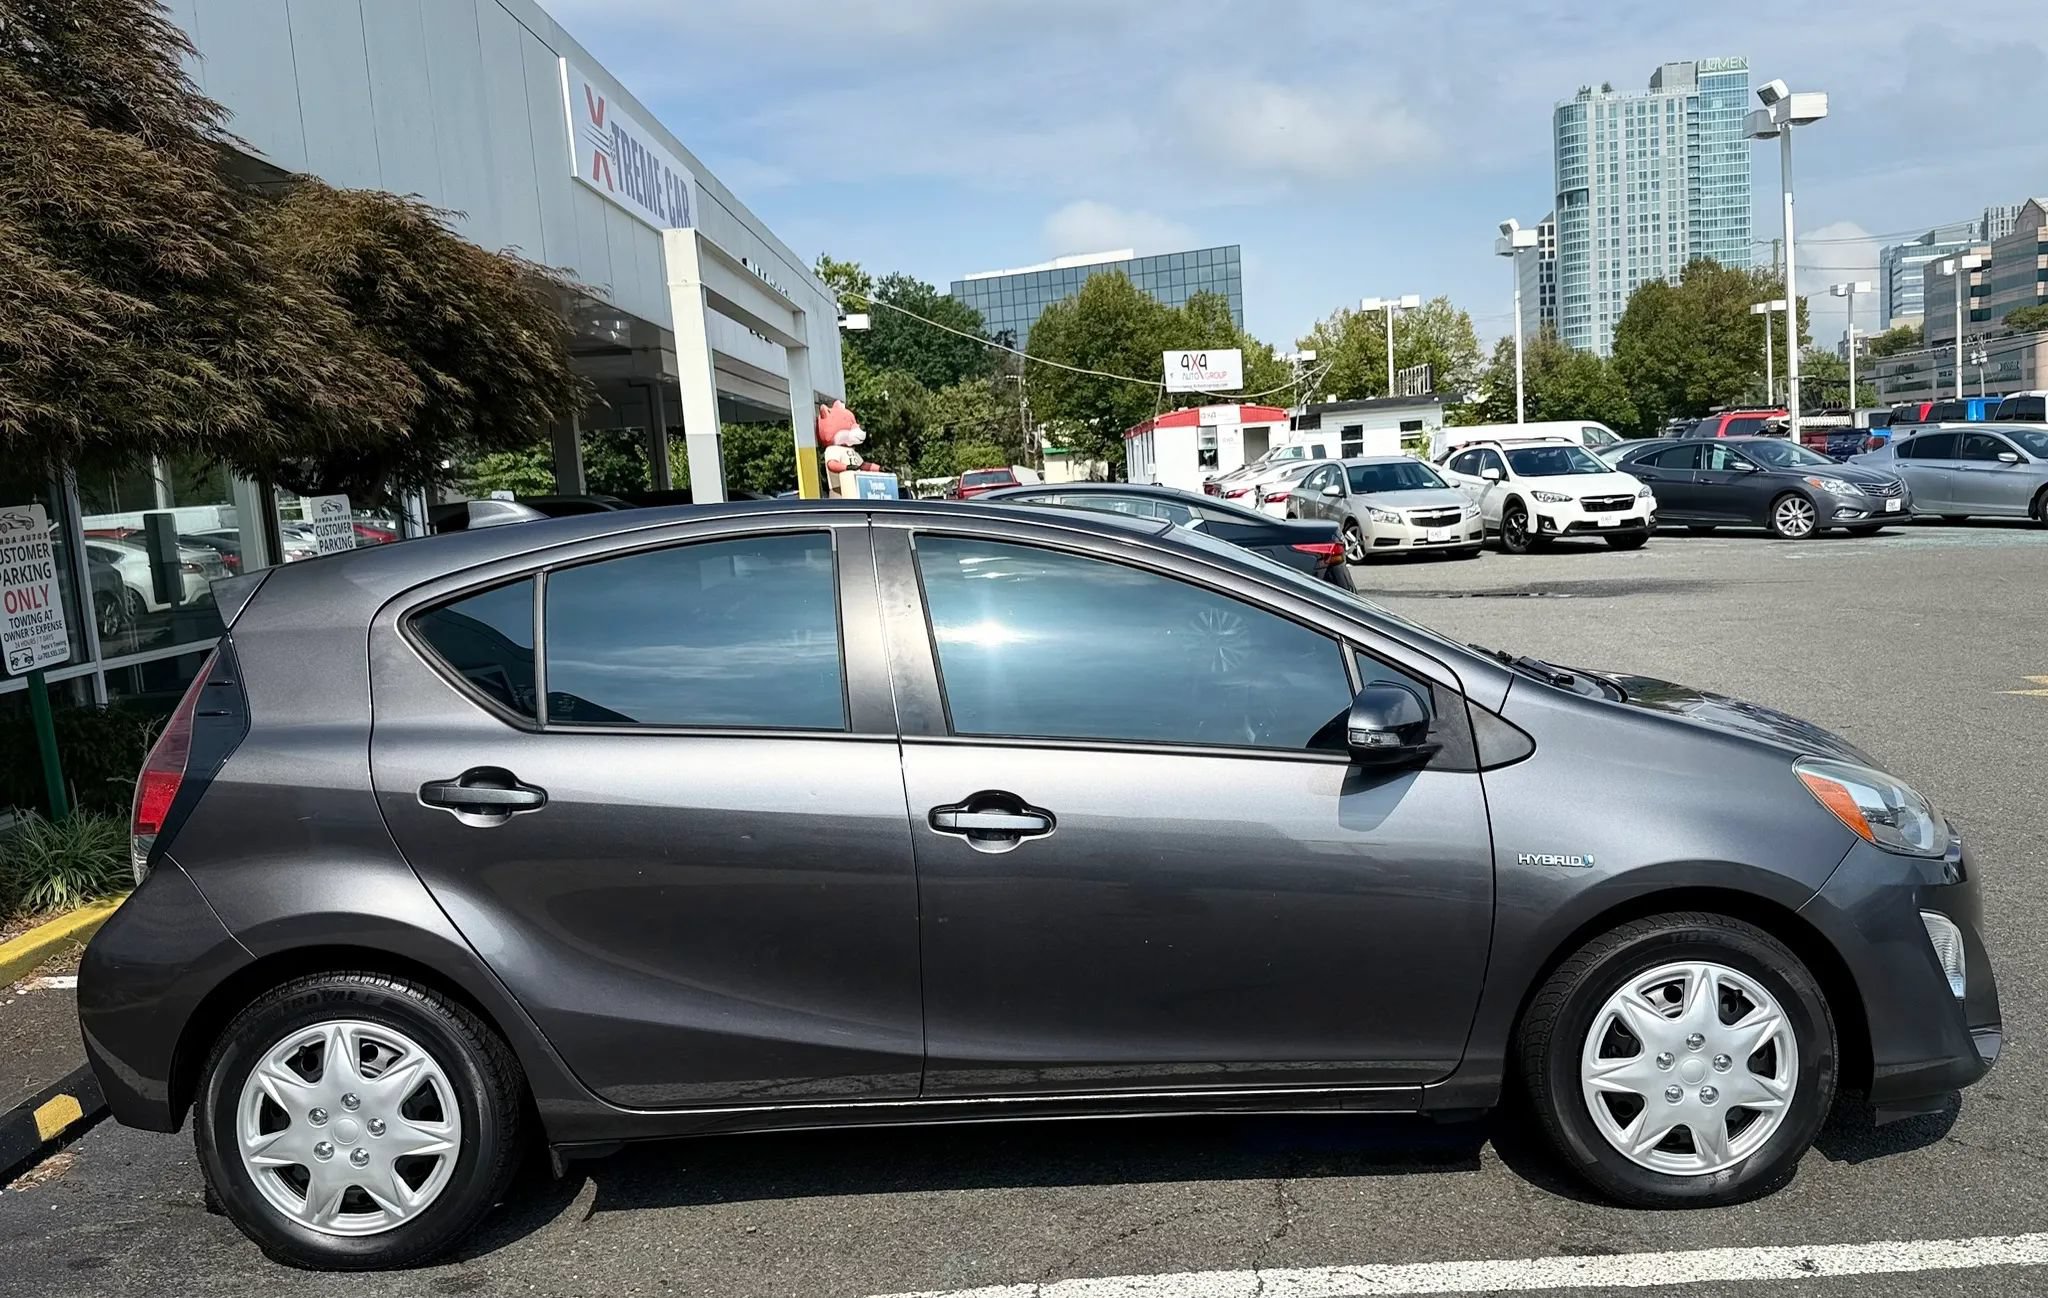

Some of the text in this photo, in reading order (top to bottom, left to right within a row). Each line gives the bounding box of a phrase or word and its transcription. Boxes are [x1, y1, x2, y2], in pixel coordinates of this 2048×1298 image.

[1699, 56, 1749, 71] LUMEN
[665, 166, 691, 228] CAR
[1183, 371, 1227, 380] AUTO GROUP
[20, 532, 48, 542] AUTOS
[316, 521, 352, 537] CUSTOMER
[319, 535, 353, 552] PARKING
[0, 562, 52, 587] ARKING
[4, 584, 49, 615] ONLY
[9, 610, 53, 629] TOWING AT
[4, 621, 63, 642] OWNER'S EXPENSE
[21, 638, 36, 647] HOURS
[1518, 853, 1582, 867] HYBRID
